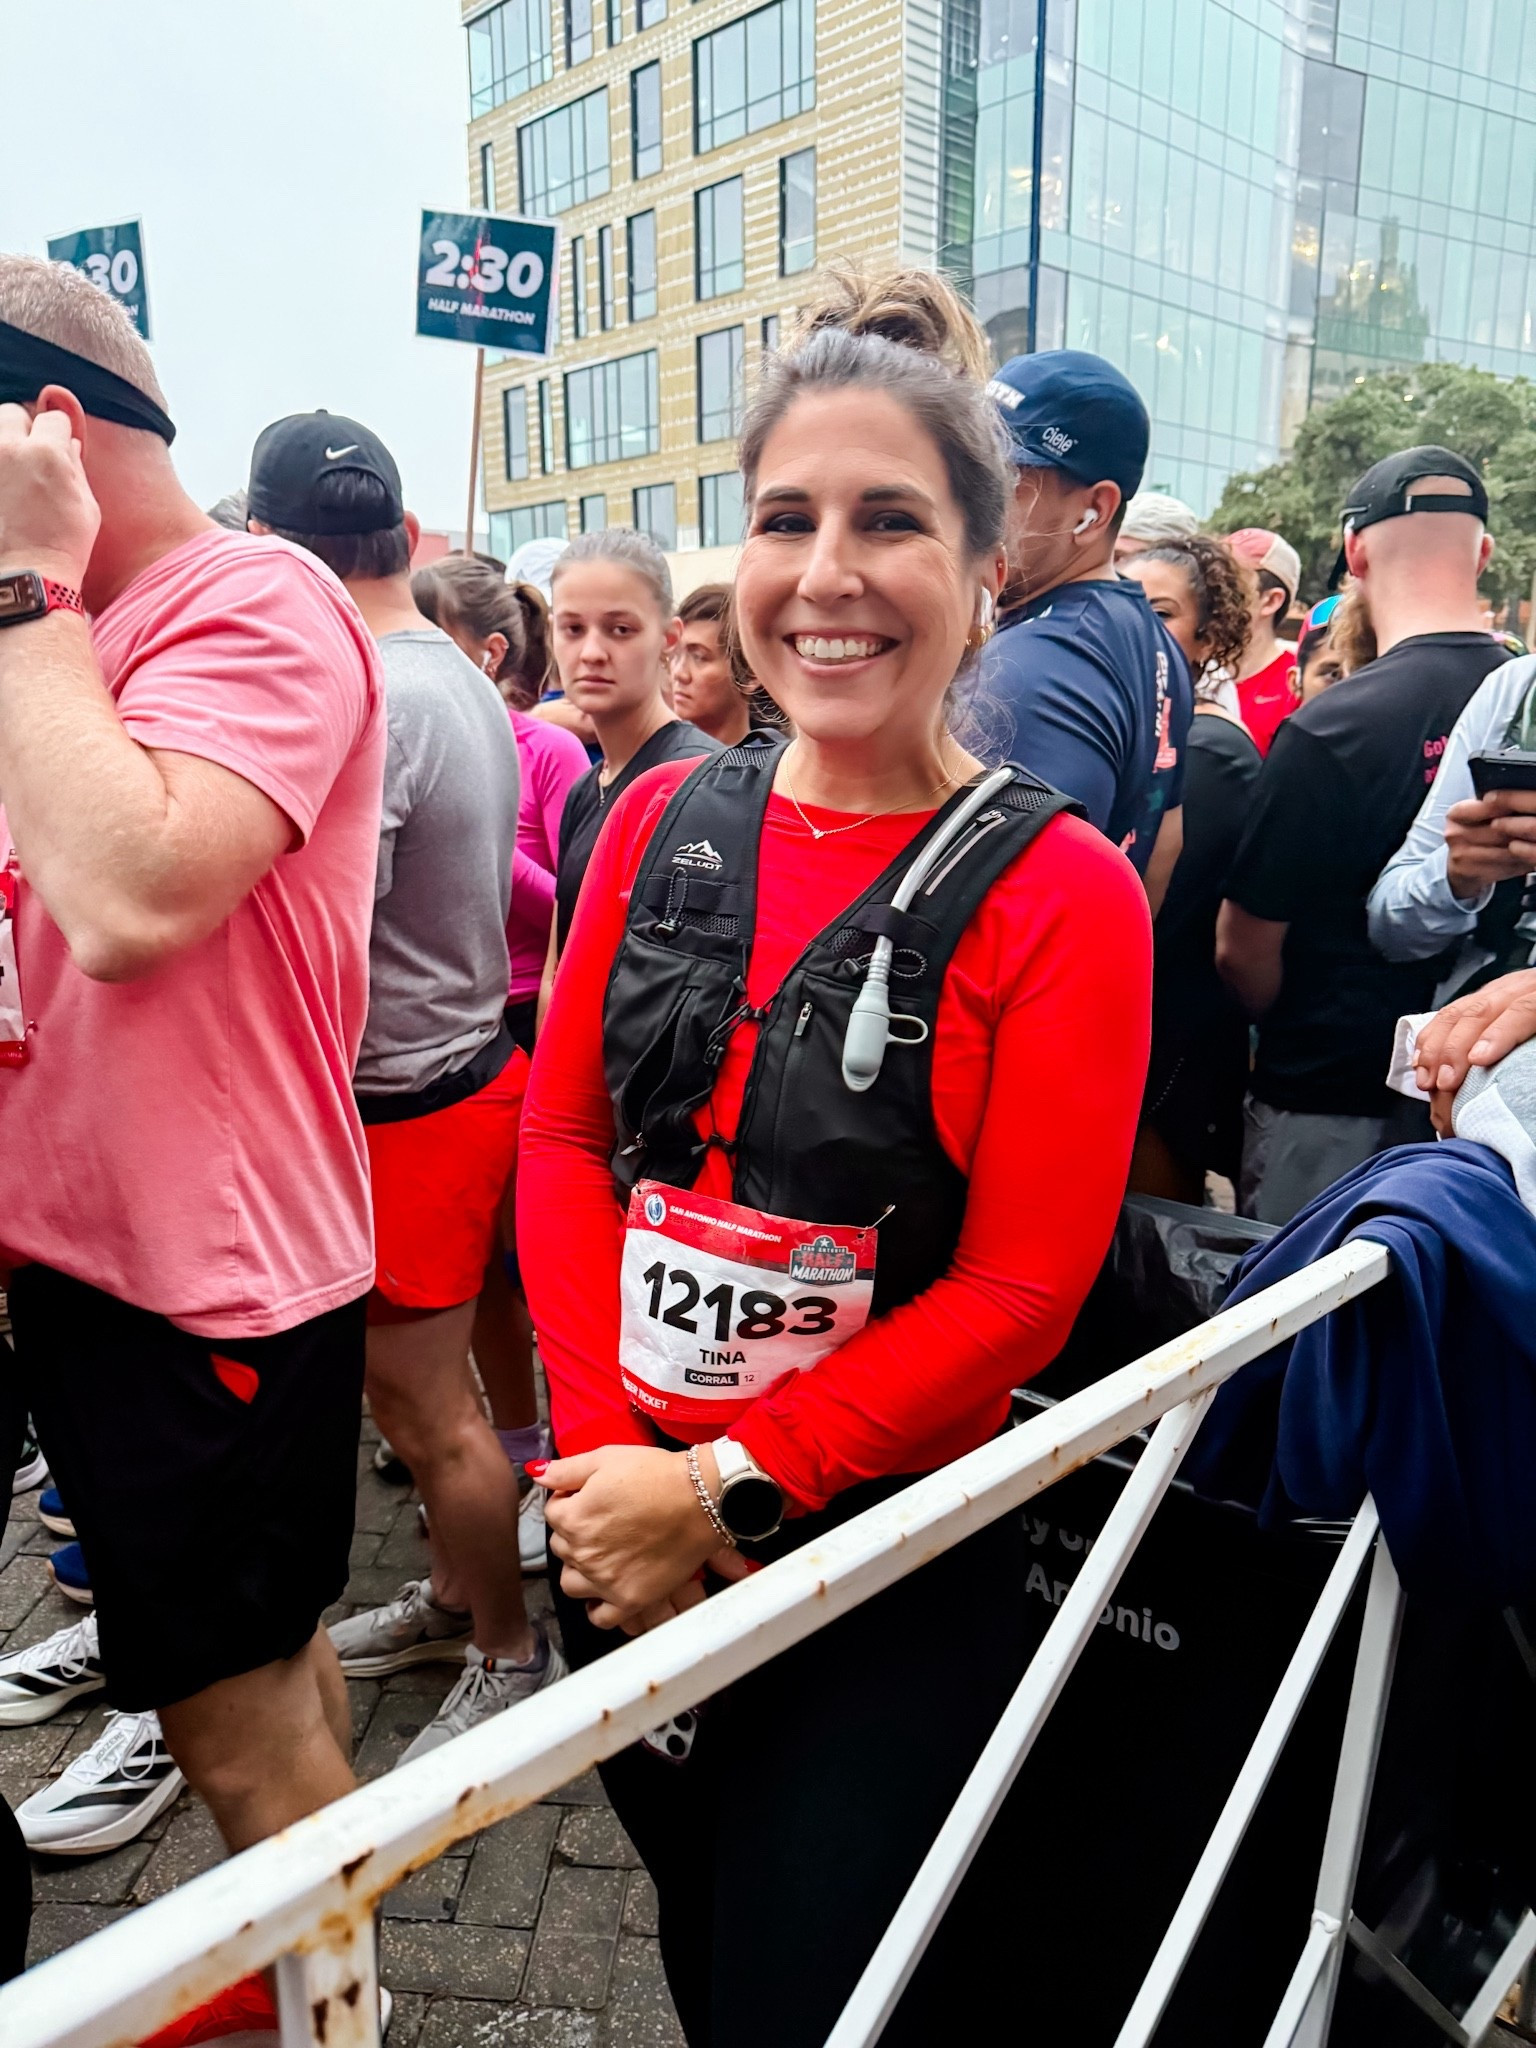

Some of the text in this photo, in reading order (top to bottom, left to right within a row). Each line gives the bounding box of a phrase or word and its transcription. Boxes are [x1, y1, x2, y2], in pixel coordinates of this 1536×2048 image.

[425, 240, 544, 298] 2:30
[428, 298, 535, 325] HALF MARATHON
[669, 1204, 685, 1216] SAN
[683, 1209, 717, 1226] ANTONIO
[716, 1219, 737, 1232] HALF
[735, 1225, 782, 1244] MARATHON
[801, 1252, 845, 1268] HALF
[791, 1264, 854, 1281] MARATHON
[642, 1261, 838, 1342] 12183
[699, 1348, 747, 1366] TINA
[689, 1372, 755, 1385] CORRAL 12
[637, 1388, 668, 1410] TICKET
[1025, 1562, 1180, 1651] Anonio
